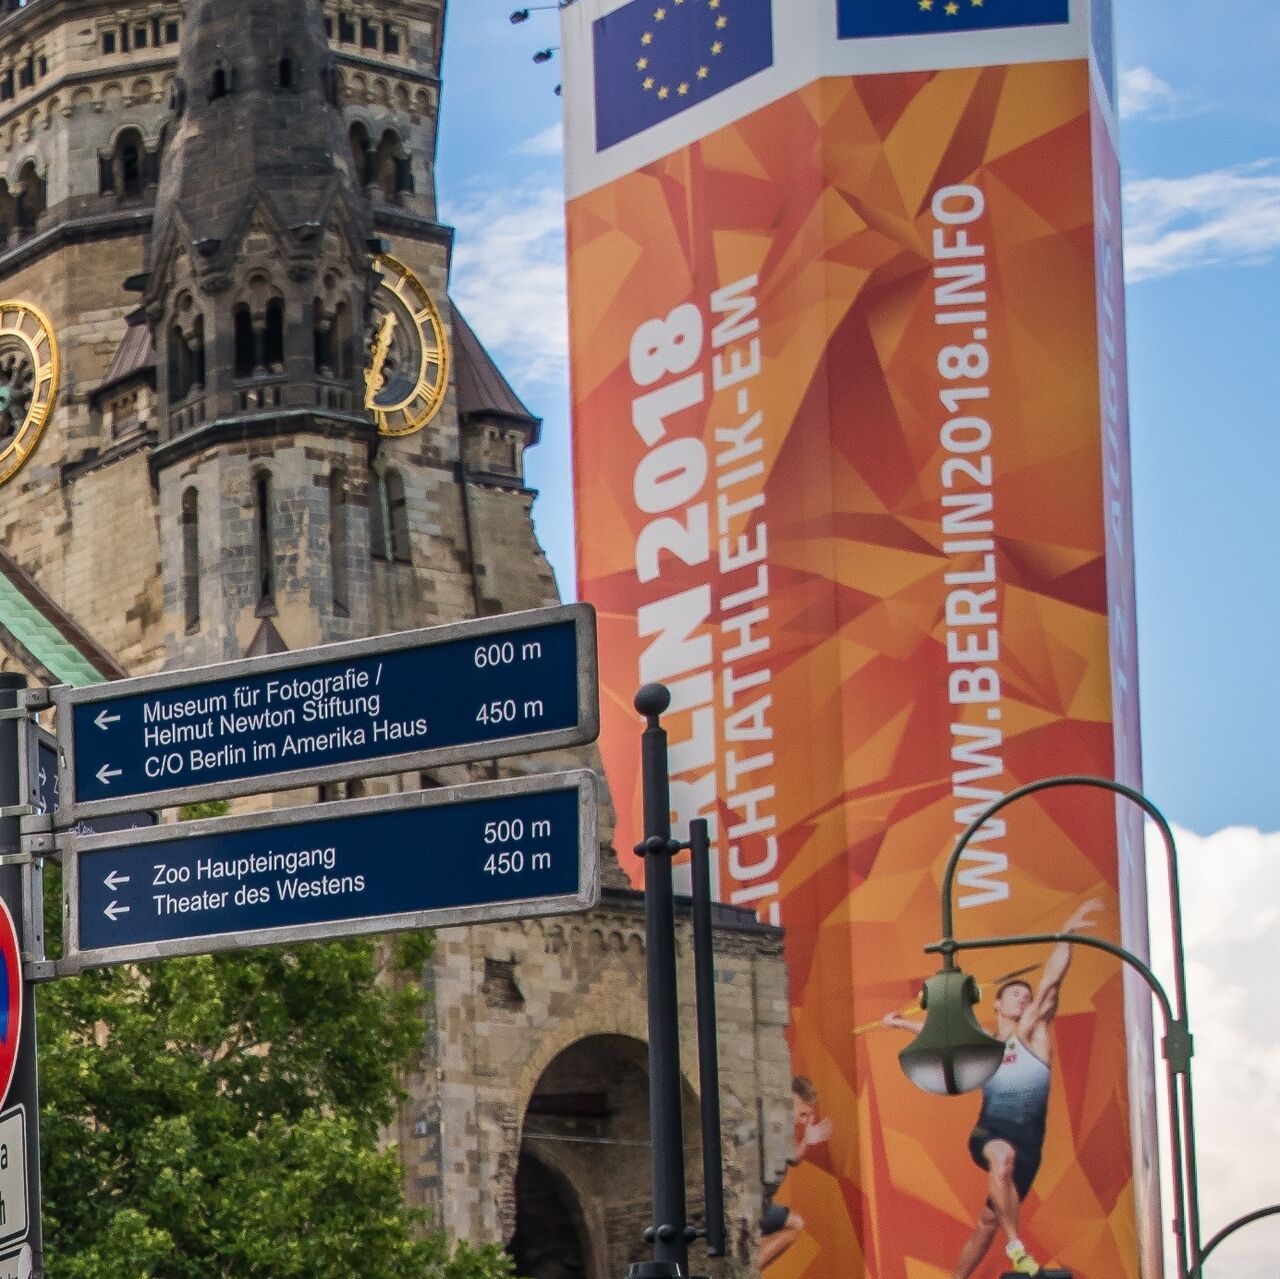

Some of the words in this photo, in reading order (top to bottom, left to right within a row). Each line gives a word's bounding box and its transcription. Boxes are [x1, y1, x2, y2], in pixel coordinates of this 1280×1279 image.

[931, 183, 1012, 909] WWW.BERLIN2018.INFO
[474, 642, 516, 668] 600
[522, 641, 542, 660] m
[144, 692, 228, 724] Museum
[233, 686, 262, 709] für
[267, 669, 369, 707] Fotografie
[475, 701, 517, 727] 450
[523, 699, 544, 718] m
[145, 720, 214, 748] Helmut
[221, 707, 296, 738] Newton
[302, 693, 382, 725] Stiftung
[145, 753, 184, 778] C/O
[190, 743, 246, 772] Berlin
[252, 737, 277, 762] im
[282, 727, 366, 758] Amerika
[372, 715, 427, 743] Haus
[483, 820, 525, 845] 500
[531, 819, 552, 838] m
[152, 862, 191, 887] Zoo
[196, 847, 337, 882] Haupteingang
[483, 852, 525, 877] 450
[531, 851, 552, 870] m
[152, 888, 230, 917] Theater
[235, 884, 271, 906] des
[276, 873, 366, 901] Westens
